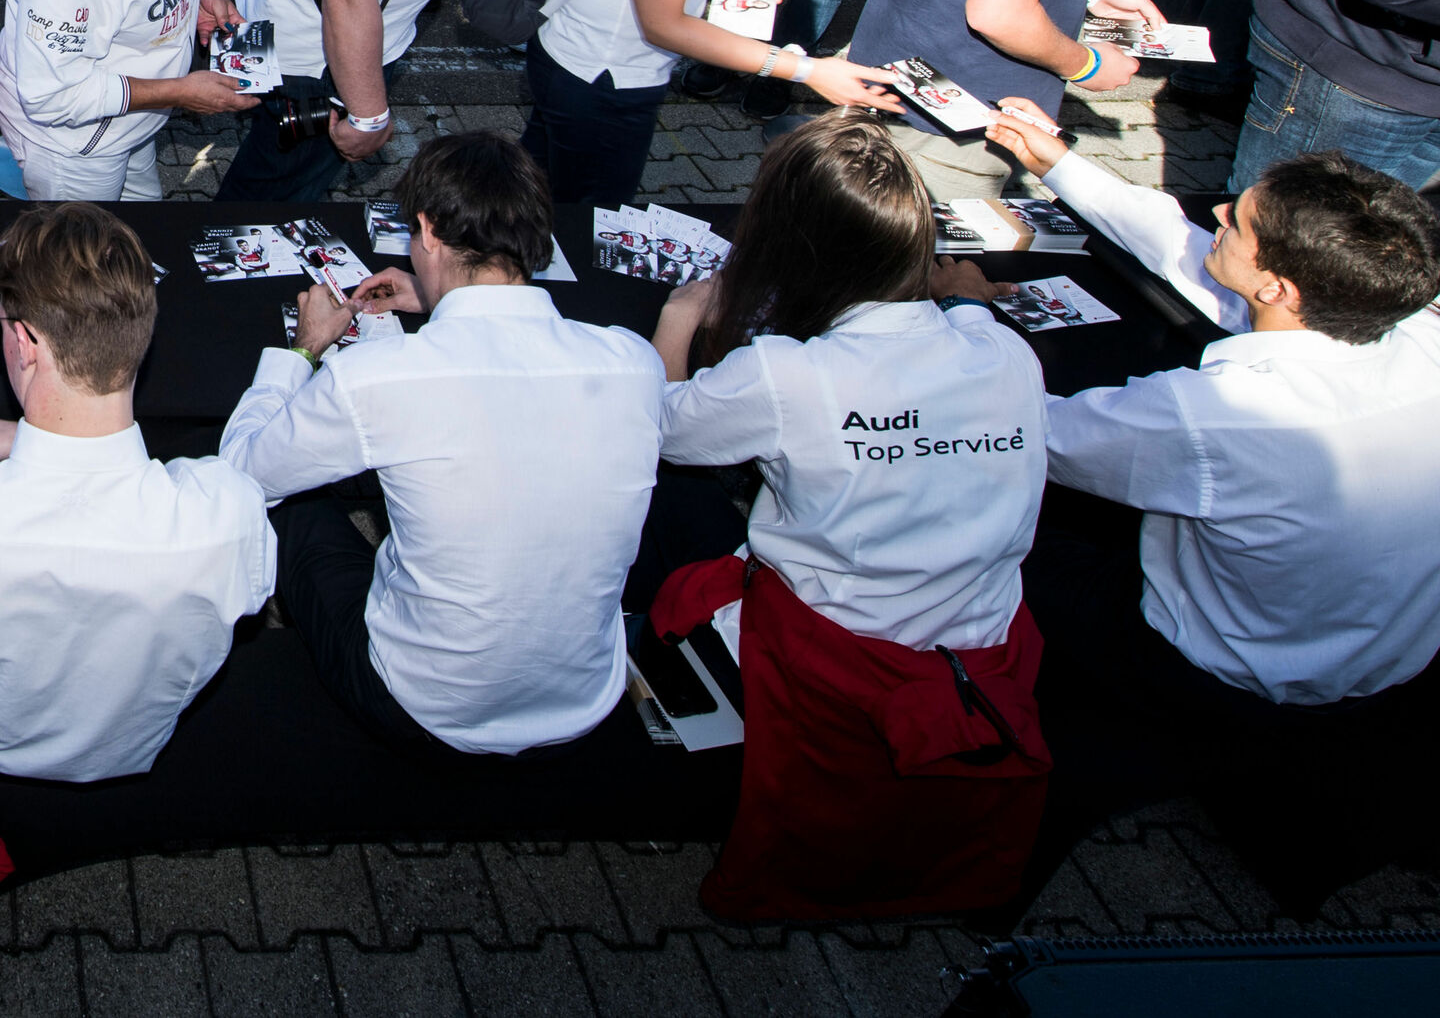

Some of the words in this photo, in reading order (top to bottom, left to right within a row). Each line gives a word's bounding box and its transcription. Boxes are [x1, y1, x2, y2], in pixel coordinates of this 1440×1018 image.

[27, 9, 53, 30] Camp
[841, 409, 919, 432] Audi
[844, 440, 904, 464] Top
